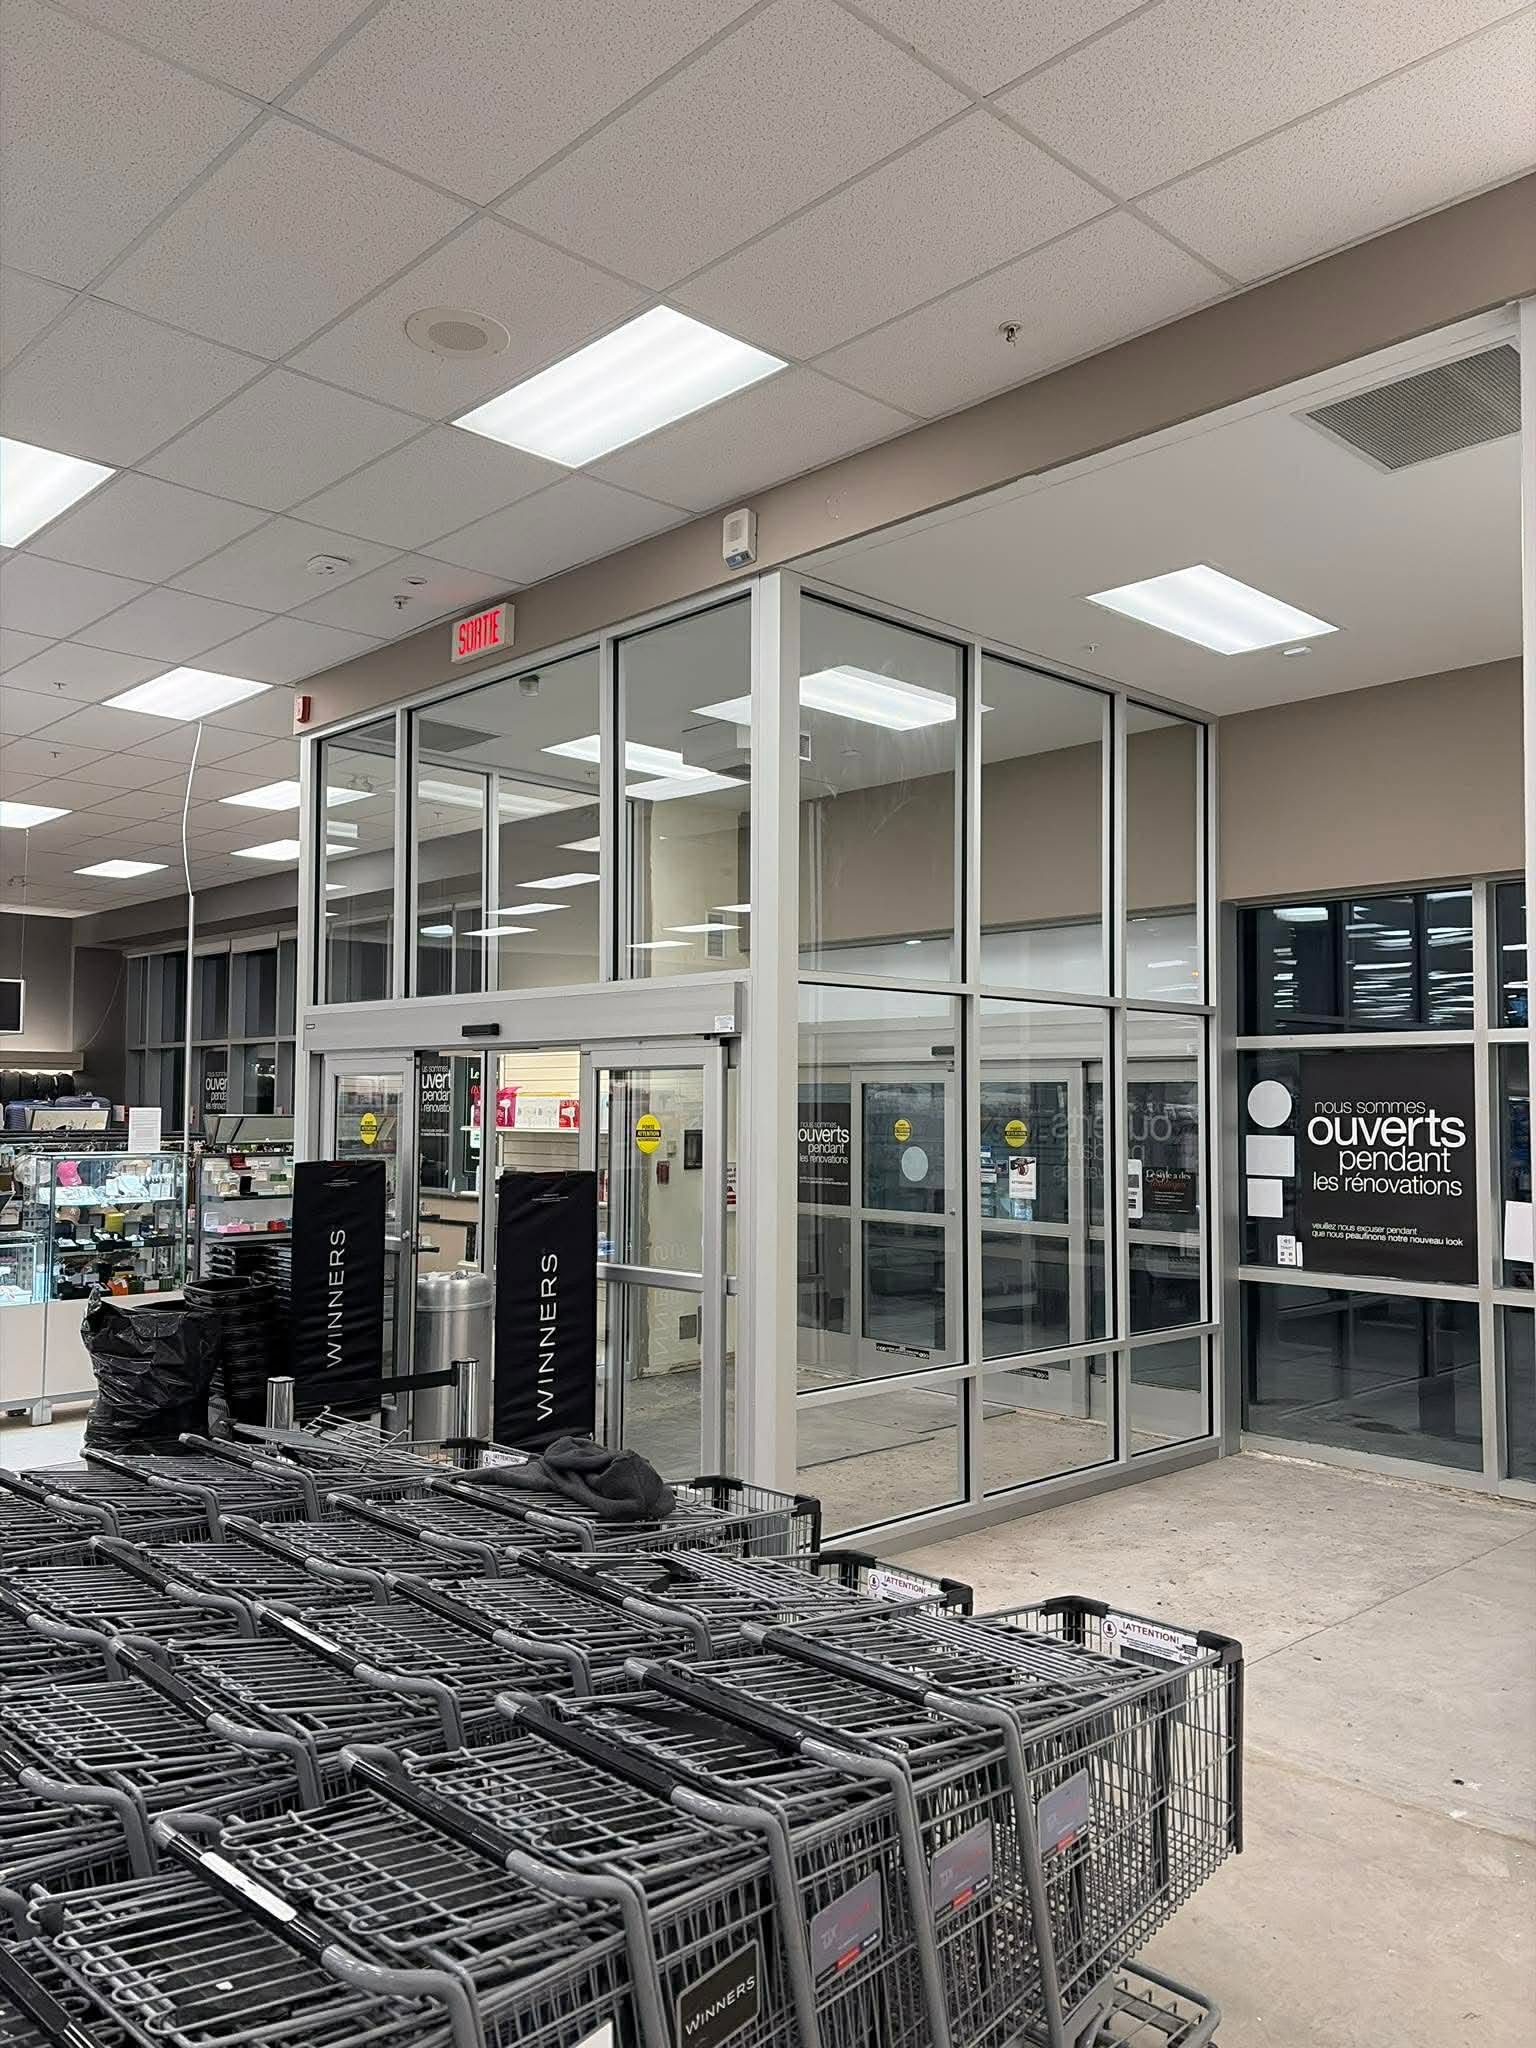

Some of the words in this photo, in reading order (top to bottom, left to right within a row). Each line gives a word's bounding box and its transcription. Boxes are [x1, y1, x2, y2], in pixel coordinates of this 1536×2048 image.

[459, 609, 501, 656] SORTIE
[205, 1078, 228, 1091] ouver
[422, 1069, 452, 1089] uvert
[1314, 1100, 1352, 1114] nous
[1356, 1100, 1426, 1115] sommes
[798, 1126, 850, 1143] ouverts
[1307, 1109, 1467, 1148] ouverts
[807, 1142, 845, 1155] pendant
[809, 1154, 849, 1164] rénovations
[1339, 1146, 1451, 1175] pendant
[1312, 1172, 1339, 1192] les
[1344, 1172, 1463, 1197] rénovations
[1311, 1222, 1337, 1231] veuillez
[1337, 1224, 1355, 1232] nous
[1386, 1226, 1417, 1236] pendant
[1311, 1230, 1326, 1238] que
[1388, 1234, 1408, 1243] notre
[1409, 1236, 1444, 1246] nouveau
[1445, 1237, 1464, 1247] look
[326, 1228, 346, 1369] WINNERS
[536, 1252, 558, 1422] WINNERS
[685, 1975, 755, 2036] WINNERS
